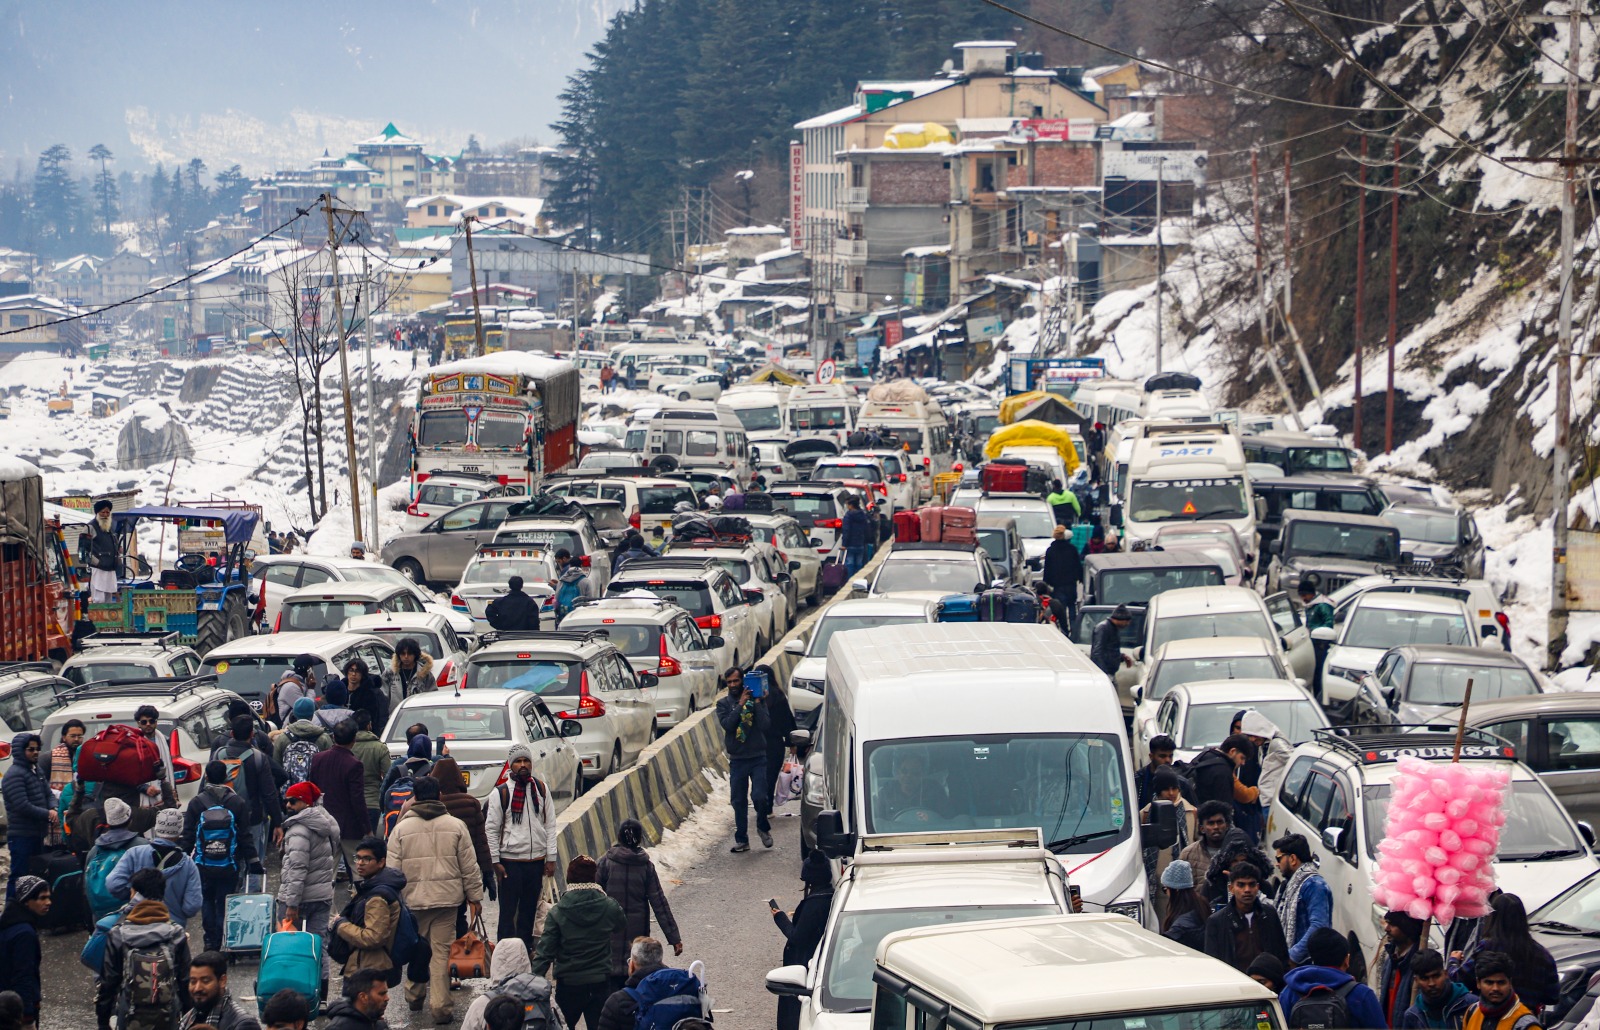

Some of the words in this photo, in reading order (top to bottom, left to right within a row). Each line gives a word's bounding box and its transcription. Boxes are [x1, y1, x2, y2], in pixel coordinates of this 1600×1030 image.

[793, 148, 801, 192] HOTEL
[793, 195, 801, 247] NEELAM
[821, 366, 832, 379] 20
[1160, 448, 1214, 457] PAZI
[1380, 745, 1500, 760] TOURIST
